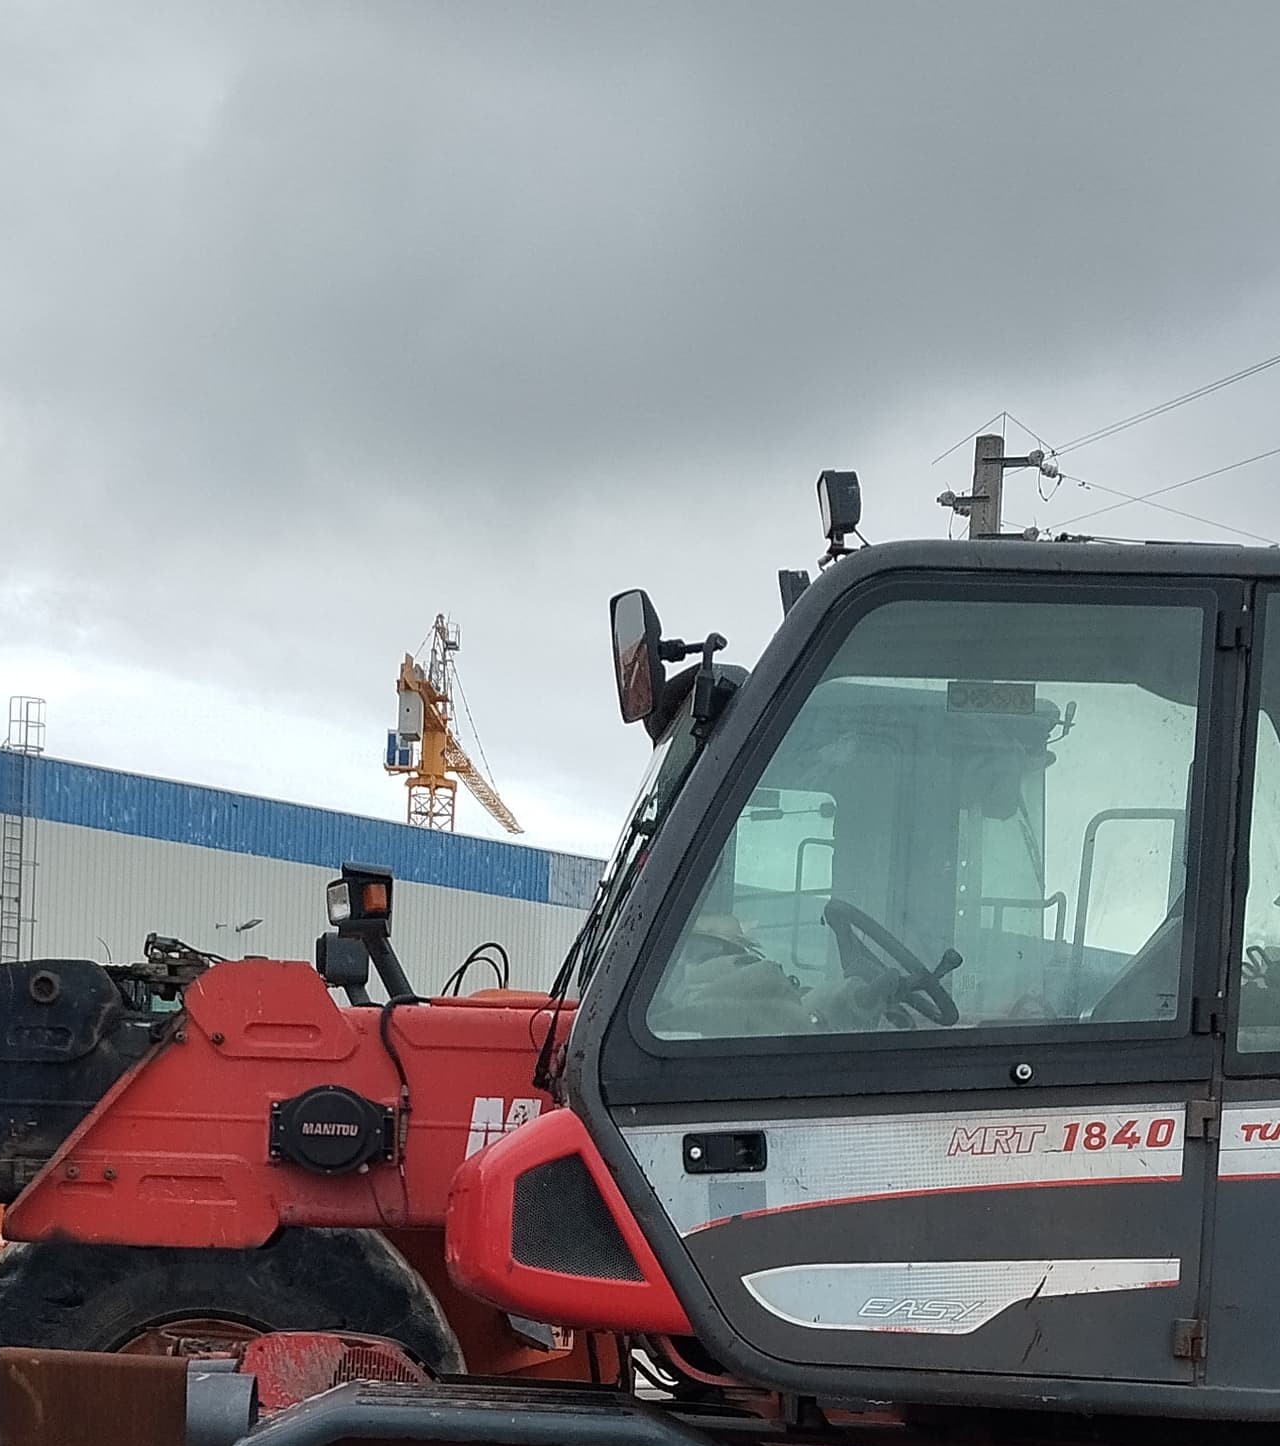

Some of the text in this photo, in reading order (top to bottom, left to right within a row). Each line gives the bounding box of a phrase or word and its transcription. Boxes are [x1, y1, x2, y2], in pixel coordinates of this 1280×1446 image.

[302, 1122, 359, 1137] MANITOU
[947, 1118, 1176, 1157] MRT 1840
[857, 1296, 988, 1322] EASY
